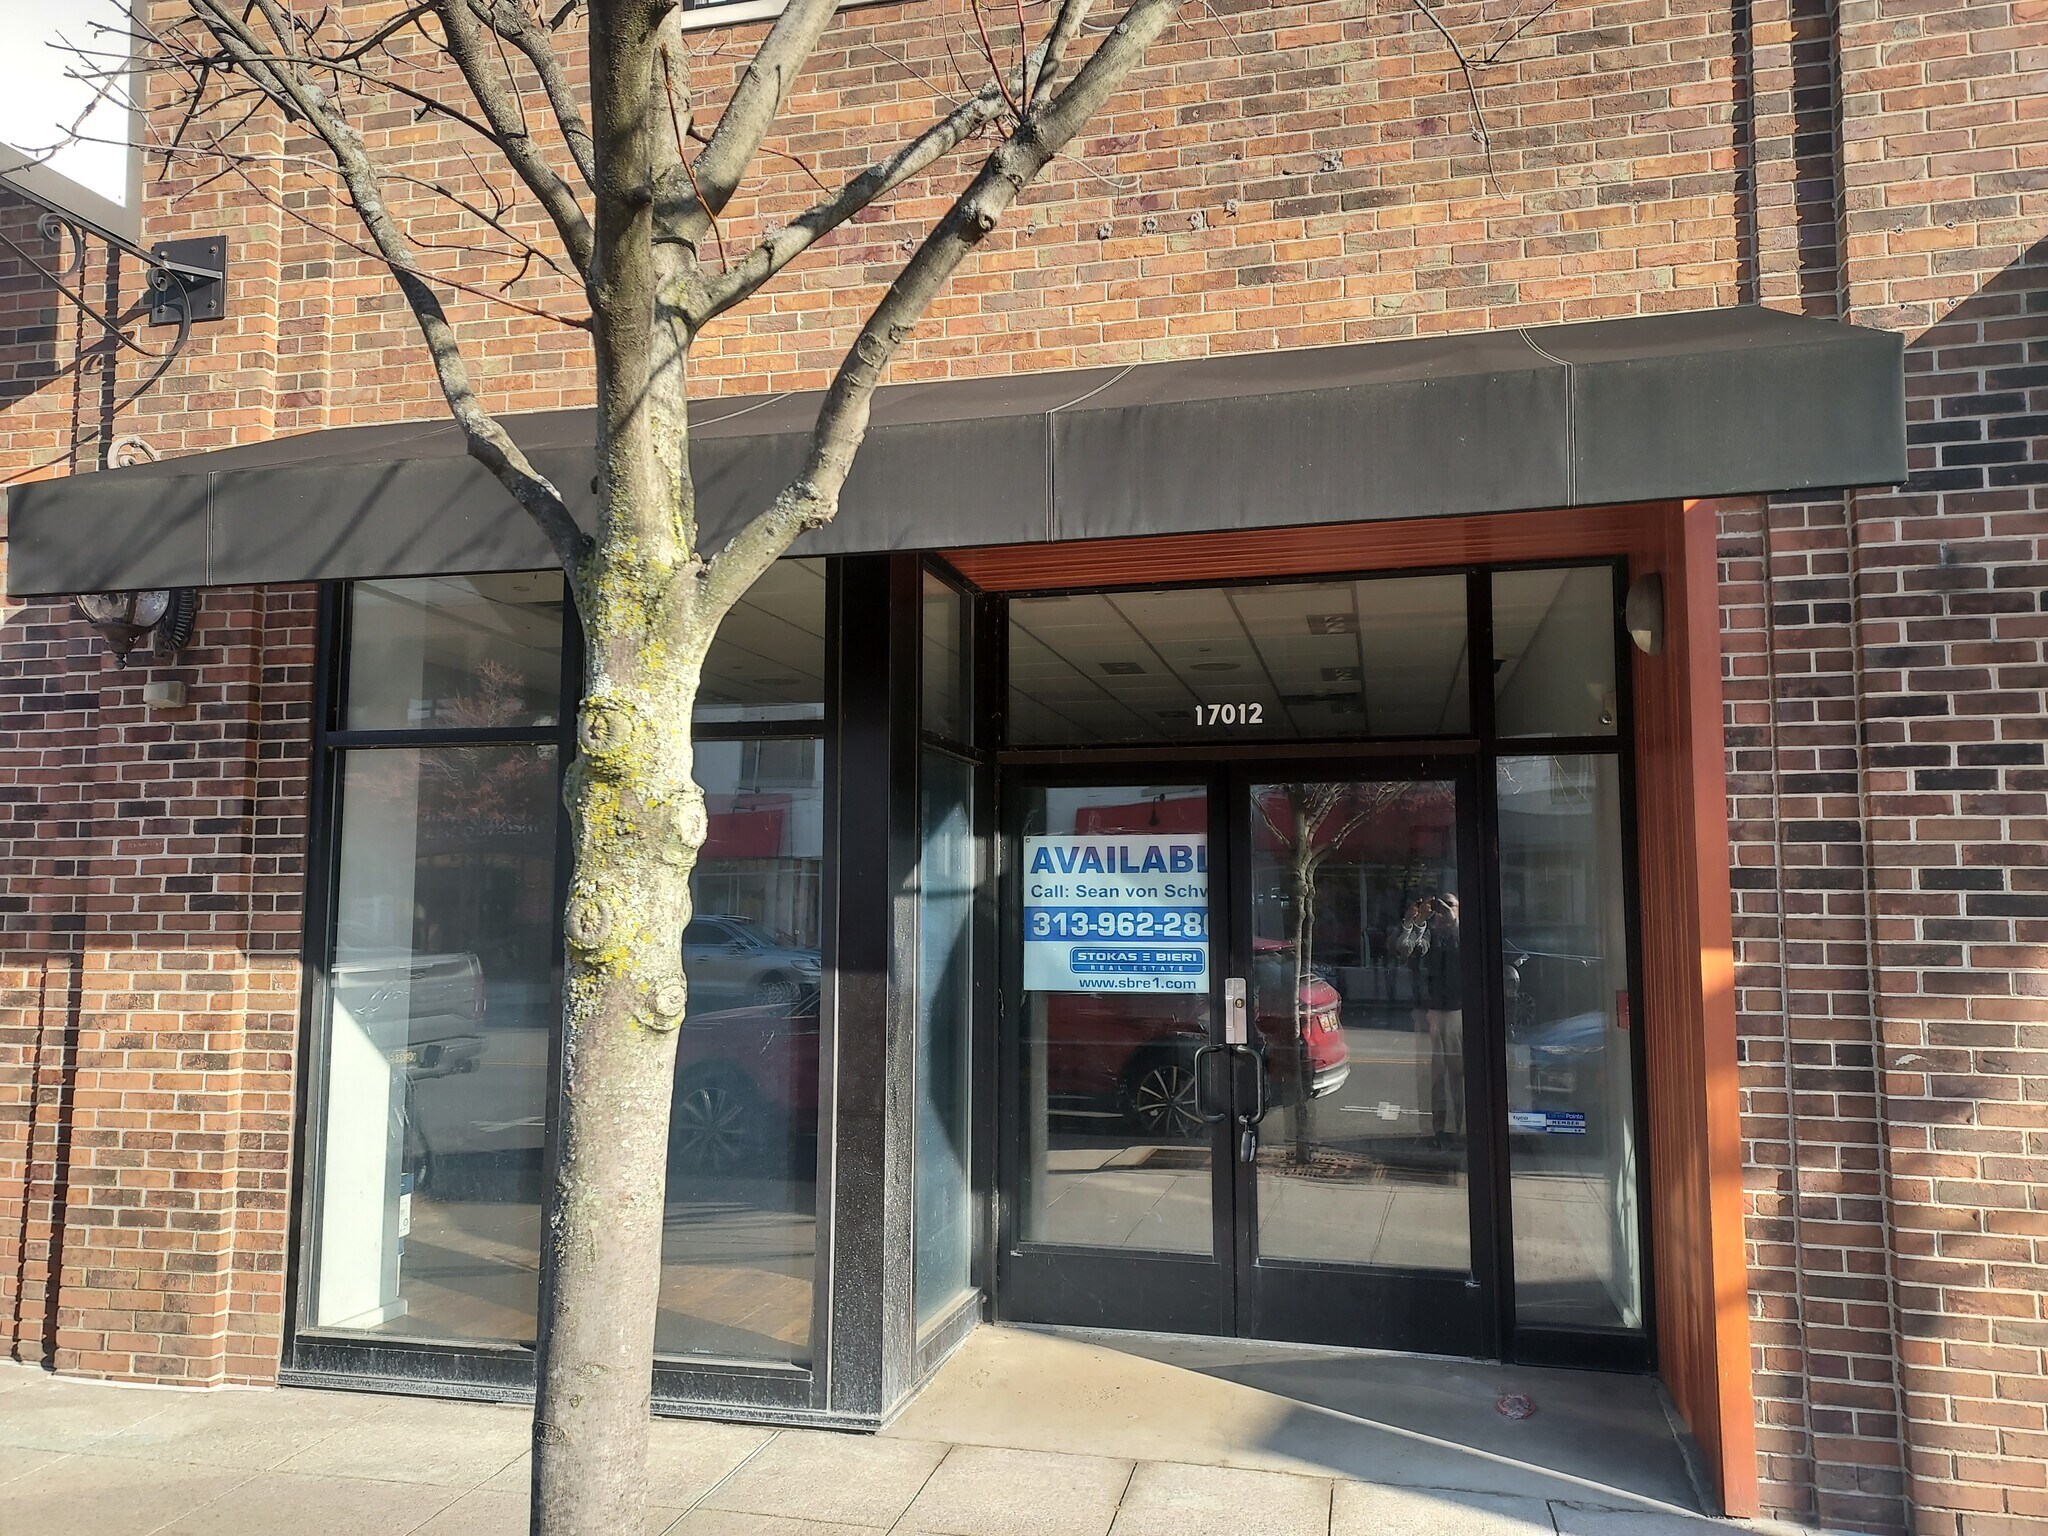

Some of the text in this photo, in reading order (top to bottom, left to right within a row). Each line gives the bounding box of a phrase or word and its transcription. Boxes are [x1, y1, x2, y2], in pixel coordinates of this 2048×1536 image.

[1195, 703, 1263, 726] 17012
[1031, 884, 1069, 898] Call:
[1076, 884, 1119, 898] Sean
[1125, 887, 1158, 898] von
[1033, 911, 1208, 937] 313-962-28
[1077, 952, 1197, 962] STOKAS BIERI
[1079, 977, 1197, 990] www.sbre1.com
